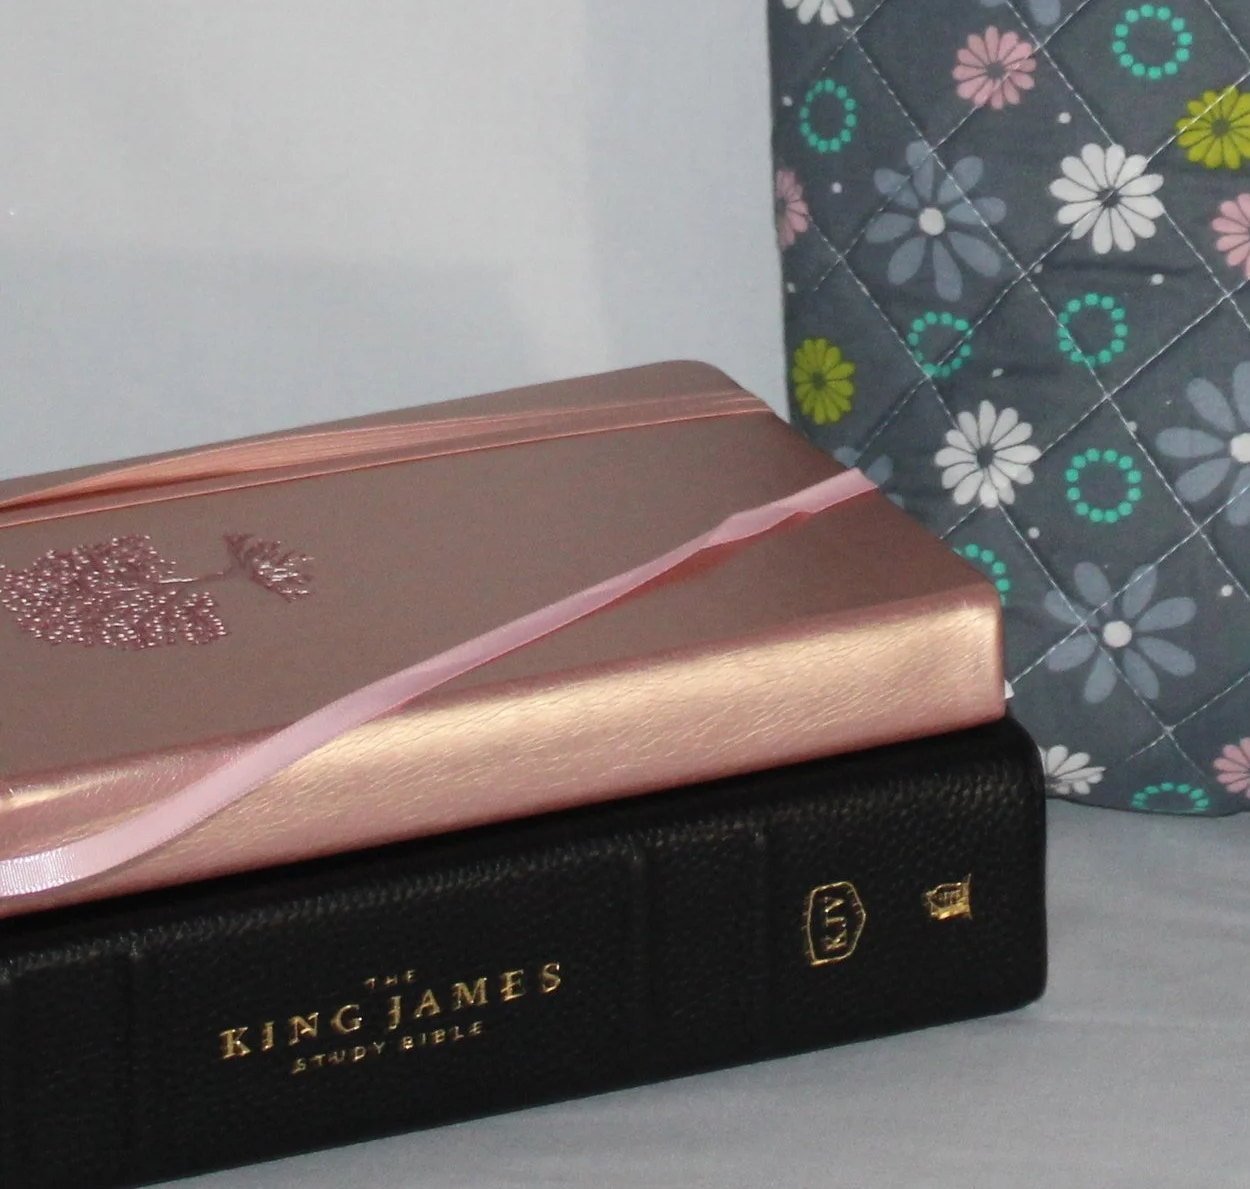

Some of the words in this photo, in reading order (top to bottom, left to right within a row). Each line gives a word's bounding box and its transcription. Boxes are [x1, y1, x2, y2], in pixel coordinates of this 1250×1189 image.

[822, 894, 848, 952] KJV
[363, 969, 416, 990] THE
[219, 1003, 364, 1061] KING
[387, 962, 563, 1031] JAMES
[291, 1040, 387, 1075] STUDY
[400, 1020, 485, 1051] BIBLE
